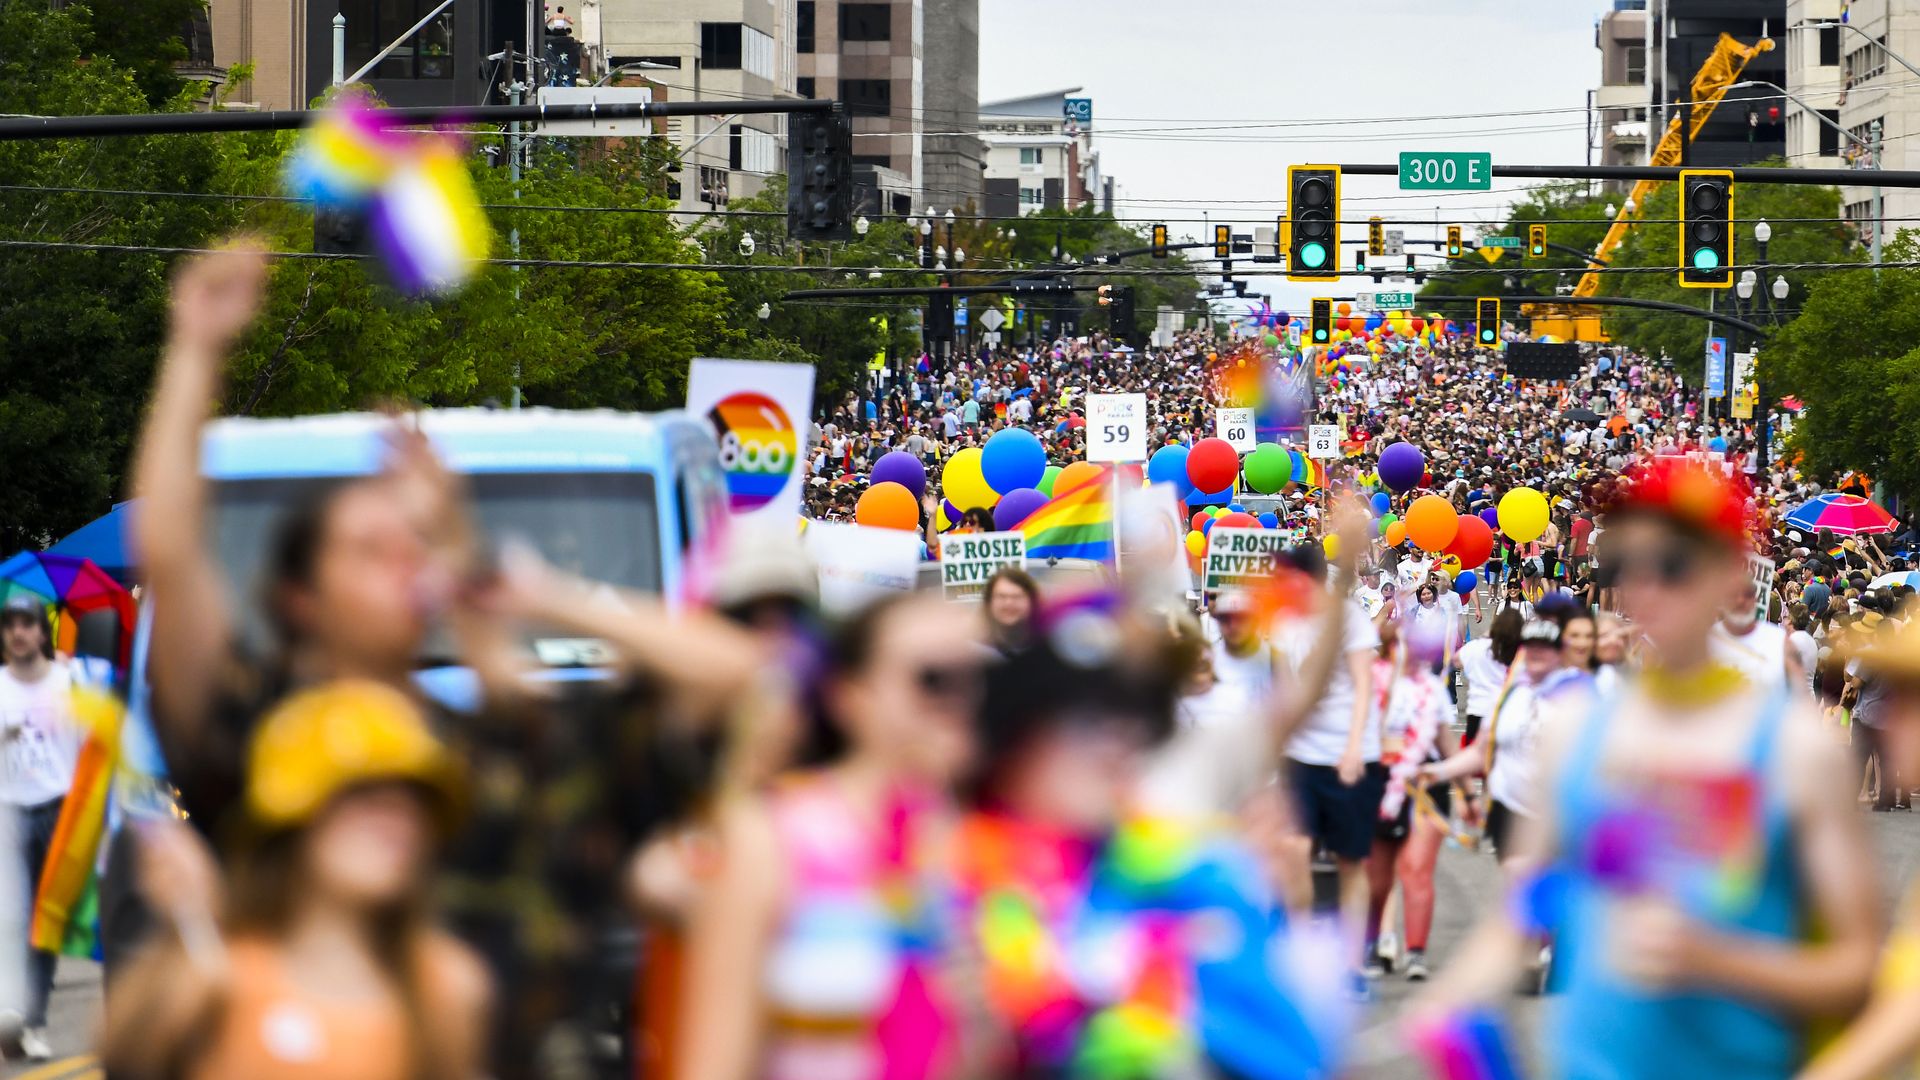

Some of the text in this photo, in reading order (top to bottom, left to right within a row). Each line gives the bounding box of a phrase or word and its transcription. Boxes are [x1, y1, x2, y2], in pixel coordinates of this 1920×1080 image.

[1066, 101, 1089, 115] AC
[1409, 158, 1482, 184] 300 E
[1381, 294, 1398, 303] 200
[1400, 294, 1408, 303] E
[1103, 424, 1130, 443] 59
[1227, 427, 1245, 441] 60
[1317, 440, 1329, 449] 63
[717, 432, 788, 474] 800
[963, 538, 1022, 559] ROSIE
